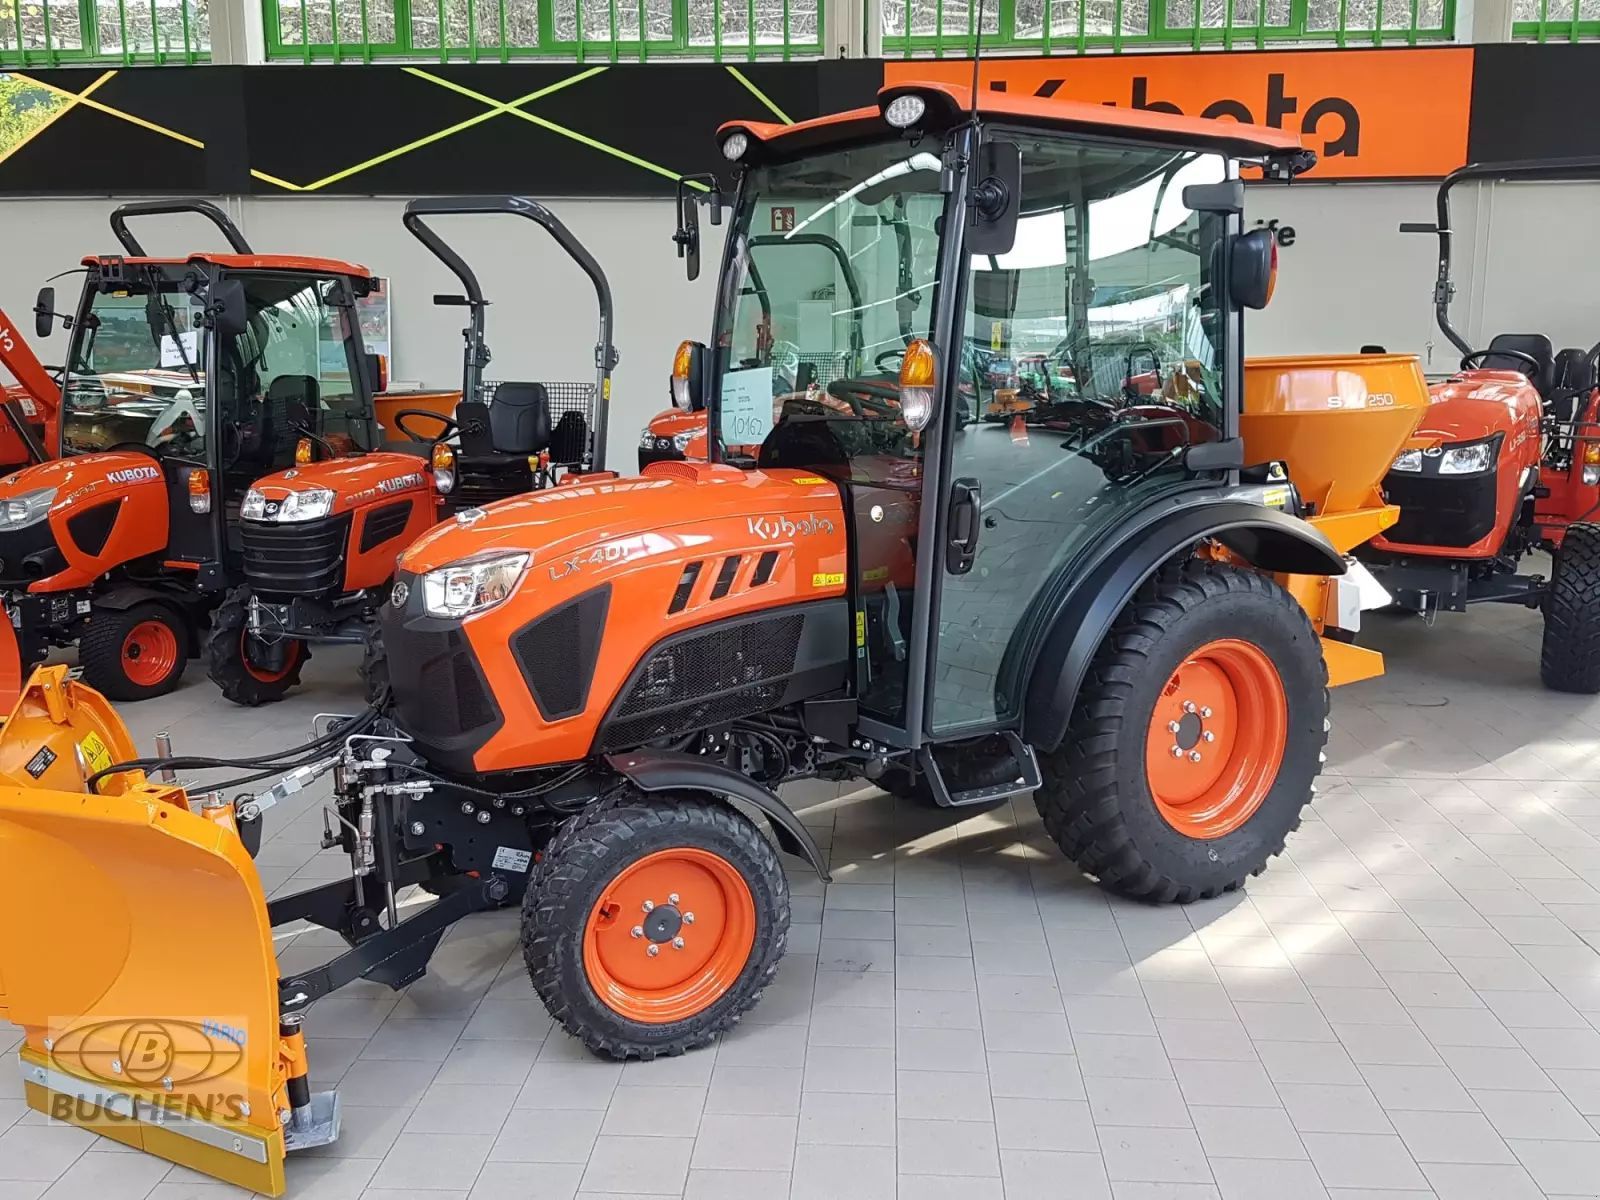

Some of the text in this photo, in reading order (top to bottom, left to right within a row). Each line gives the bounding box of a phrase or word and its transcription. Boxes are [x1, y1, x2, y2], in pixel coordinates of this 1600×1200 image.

[1367, 392, 1395, 408] 250
[732, 416, 763, 441] 10162
[106, 466, 159, 484] KUBOTA
[378, 472, 425, 493] KUBOTA
[747, 512, 834, 540] Kubota
[203, 1019, 246, 1045] VARIO
